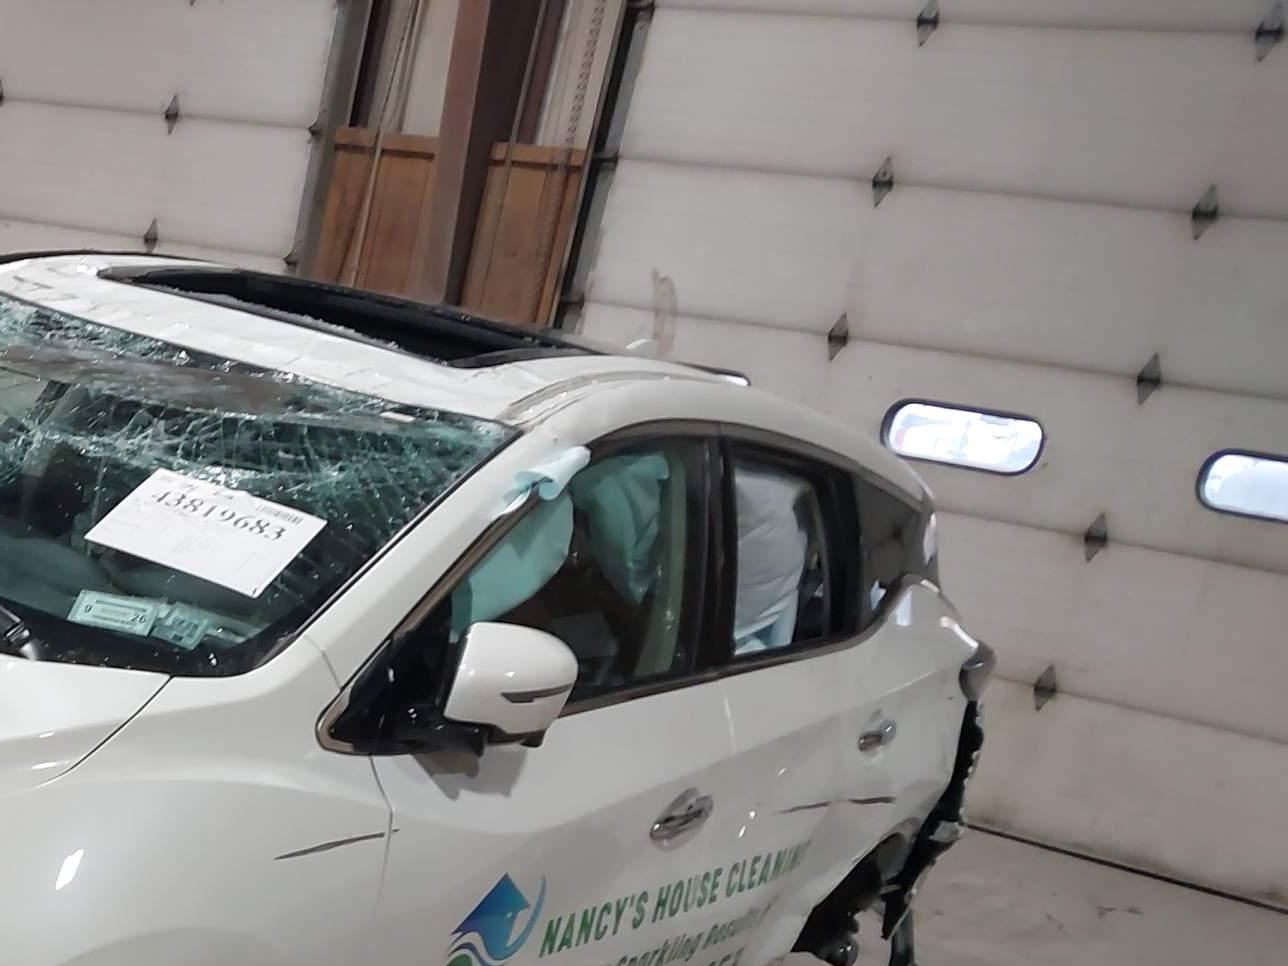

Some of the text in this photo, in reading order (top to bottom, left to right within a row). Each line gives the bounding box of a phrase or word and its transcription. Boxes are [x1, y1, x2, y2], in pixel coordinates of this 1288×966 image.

[151, 490, 287, 541] 43819683
[130, 612, 147, 624] 26
[539, 890, 649, 958] NANCY'S
[652, 867, 722, 924] HOUSE
